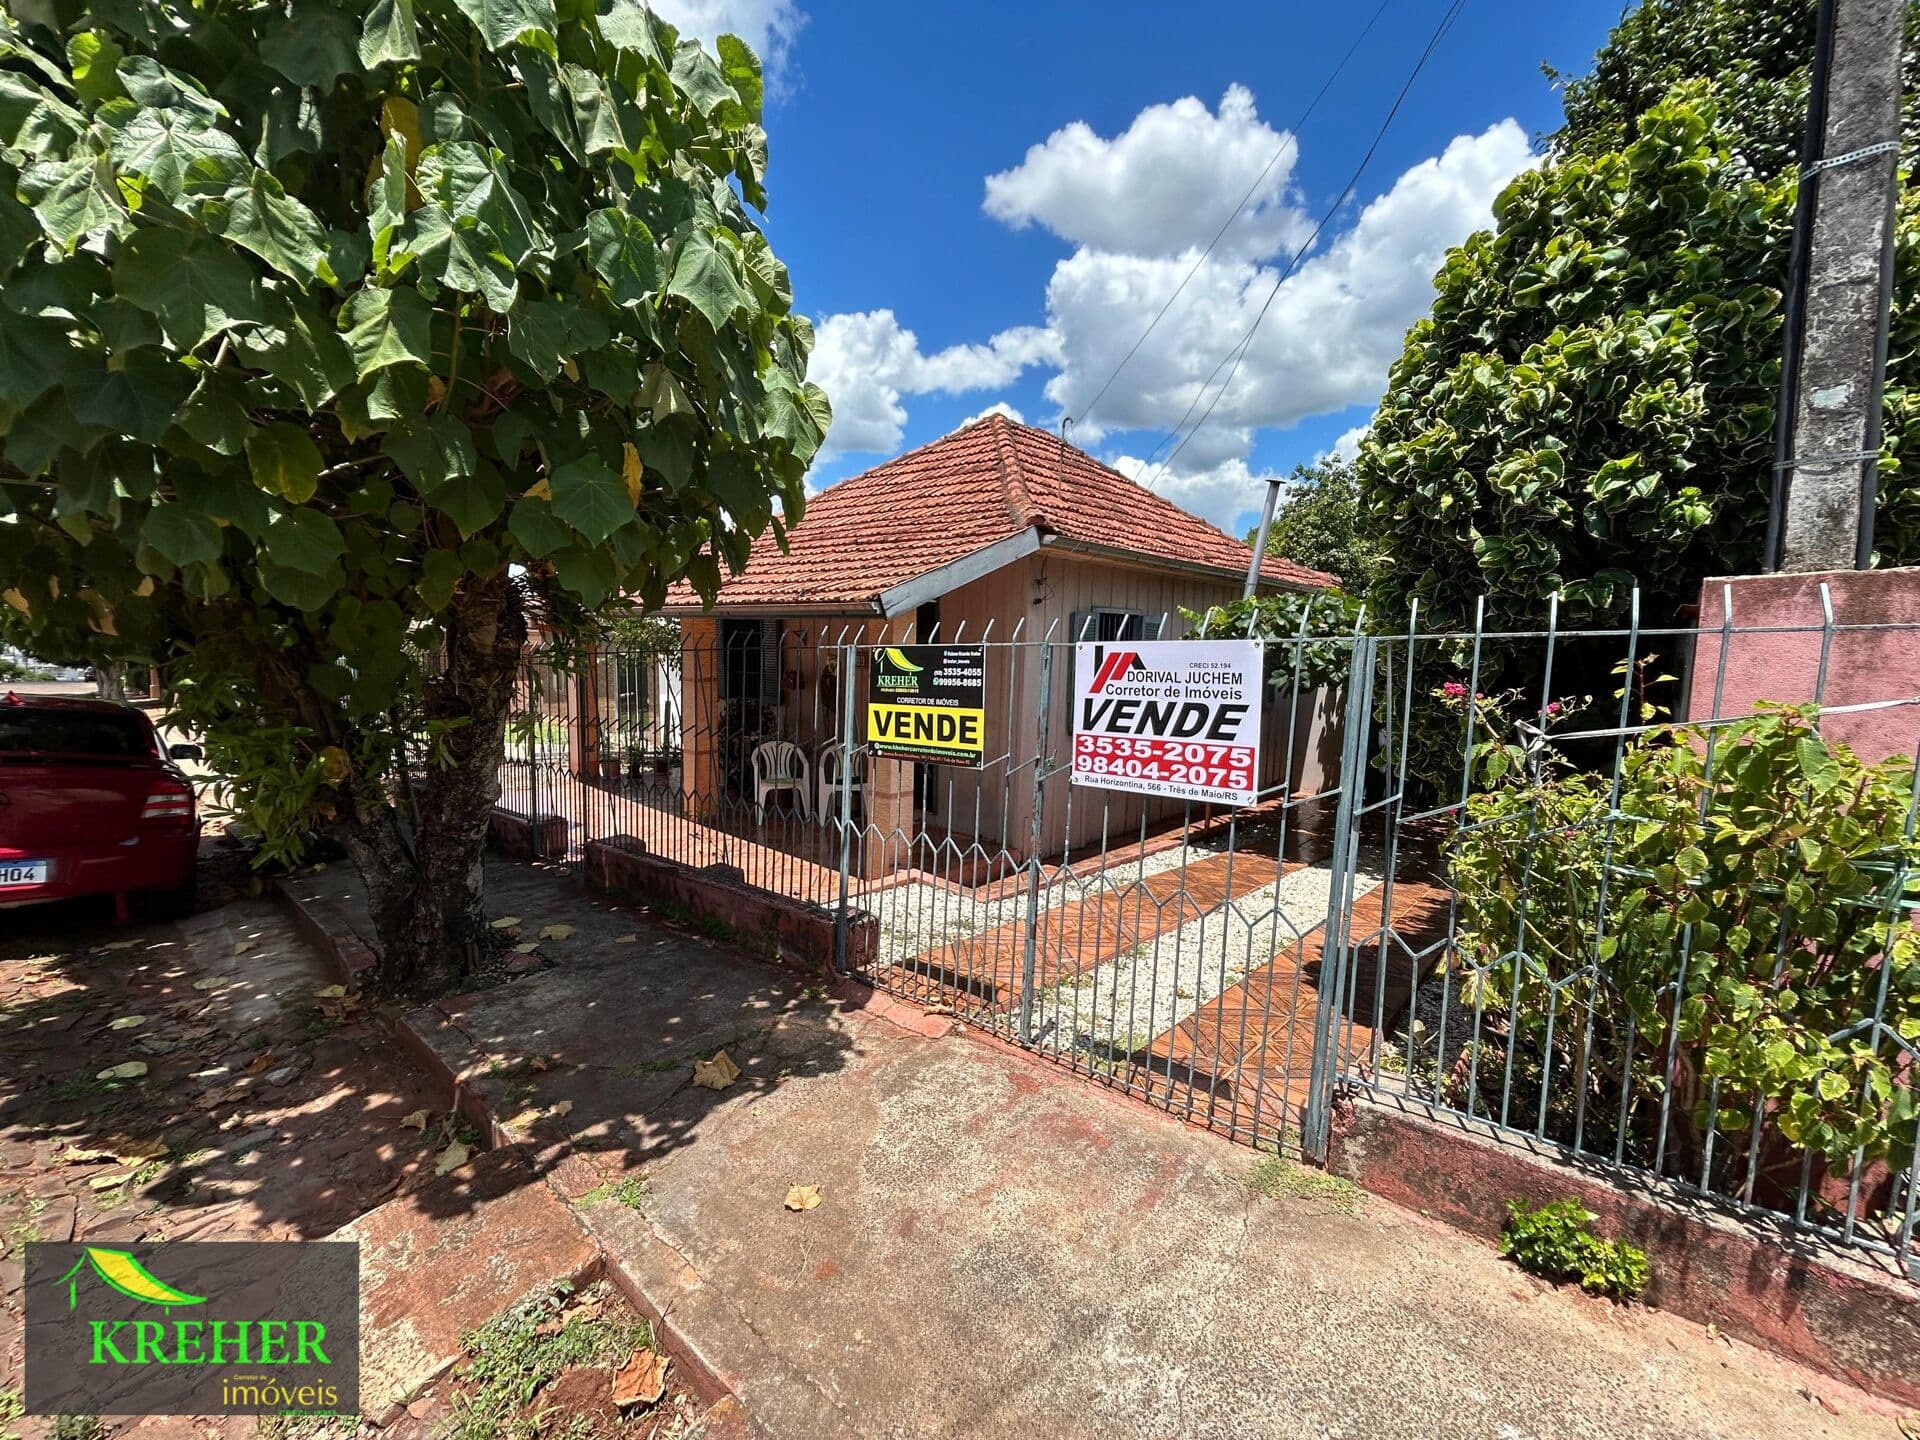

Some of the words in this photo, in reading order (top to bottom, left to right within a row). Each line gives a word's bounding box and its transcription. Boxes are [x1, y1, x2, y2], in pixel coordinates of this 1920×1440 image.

[878, 675, 918, 687] KREHER
[943, 668, 982, 677] 3535-4055
[1127, 671, 1182, 684] DORIVAL
[1185, 672, 1243, 685] JUCHEM
[897, 697, 927, 705] CORRETOR
[1105, 684, 1161, 697] Corretor
[1164, 685, 1181, 698] de
[1185, 686, 1243, 700] Imóveis
[873, 710, 977, 745] VENDE
[1082, 698, 1250, 741] VENDE
[1078, 736, 1251, 767] 3535-2075
[1077, 755, 1248, 789] 98404-2075
[1084, 775, 1099, 784] Rua
[1100, 776, 1145, 791] Horizontina,
[1147, 783, 1161, 792] 566
[1169, 785, 1186, 794] Três
[1189, 787, 1199, 796] de
[1201, 790, 1238, 801] Maio/RS
